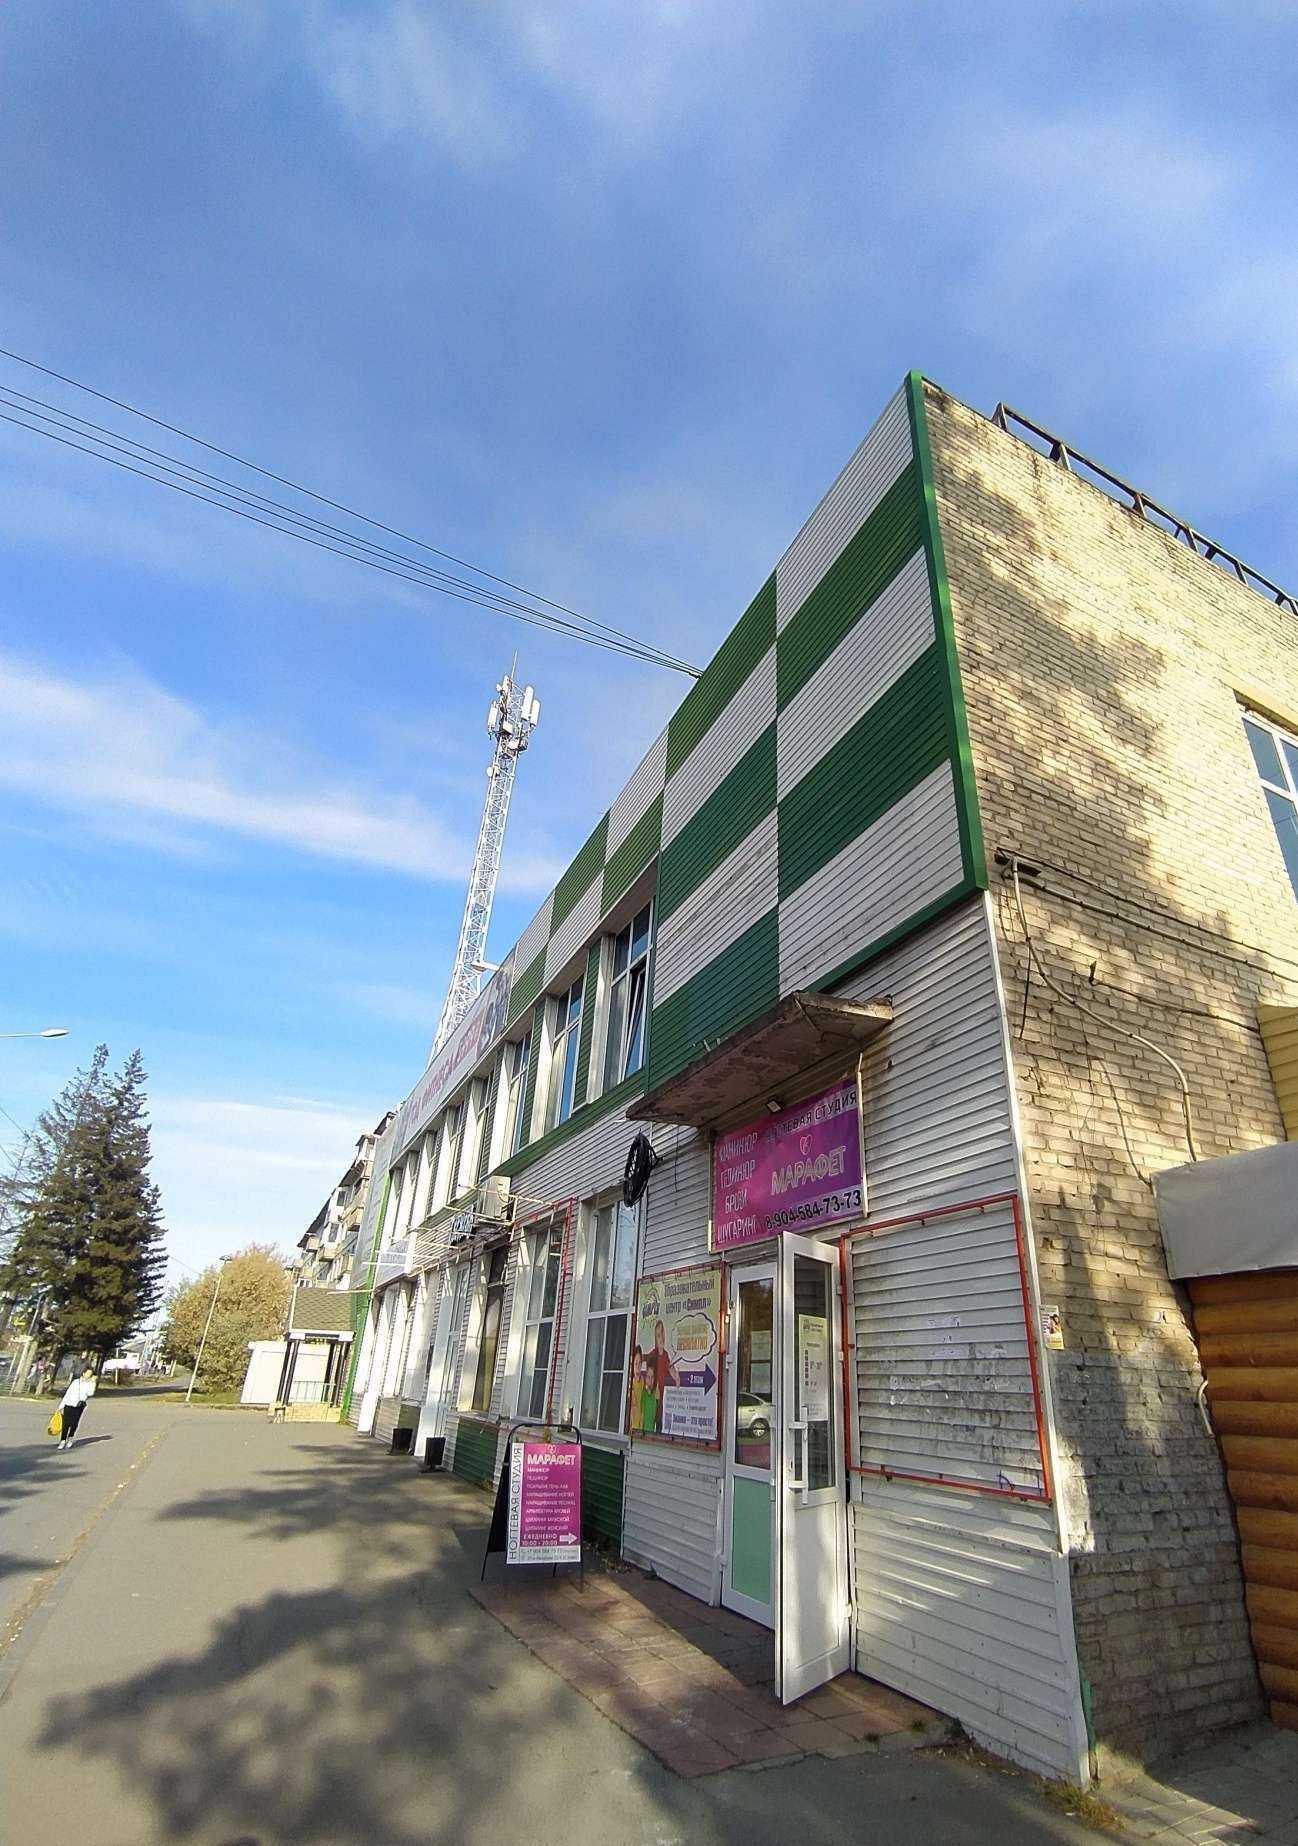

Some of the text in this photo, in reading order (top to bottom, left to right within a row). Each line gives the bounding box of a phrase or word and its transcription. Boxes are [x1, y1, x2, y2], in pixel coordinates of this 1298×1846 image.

[815, 1091, 857, 1120] СТУДИЯ
[721, 1159, 756, 1189] ПЕДИКЮР
[771, 1145, 847, 1196] МАРАФЕТ
[725, 1189, 748, 1214] БРОВИ
[765, 1189, 862, 1230] 8-904-584-73-73
[717, 1214, 757, 1244] ШУГАРИНГ
[665, 1278, 715, 1298] Образовательный
[690, 1374, 694, 1384] 2
[527, 1453, 576, 1466] МАРАФЕТ
[509, 1448, 522, 1560] НОГТЕВАЯ СТУДИЯ
